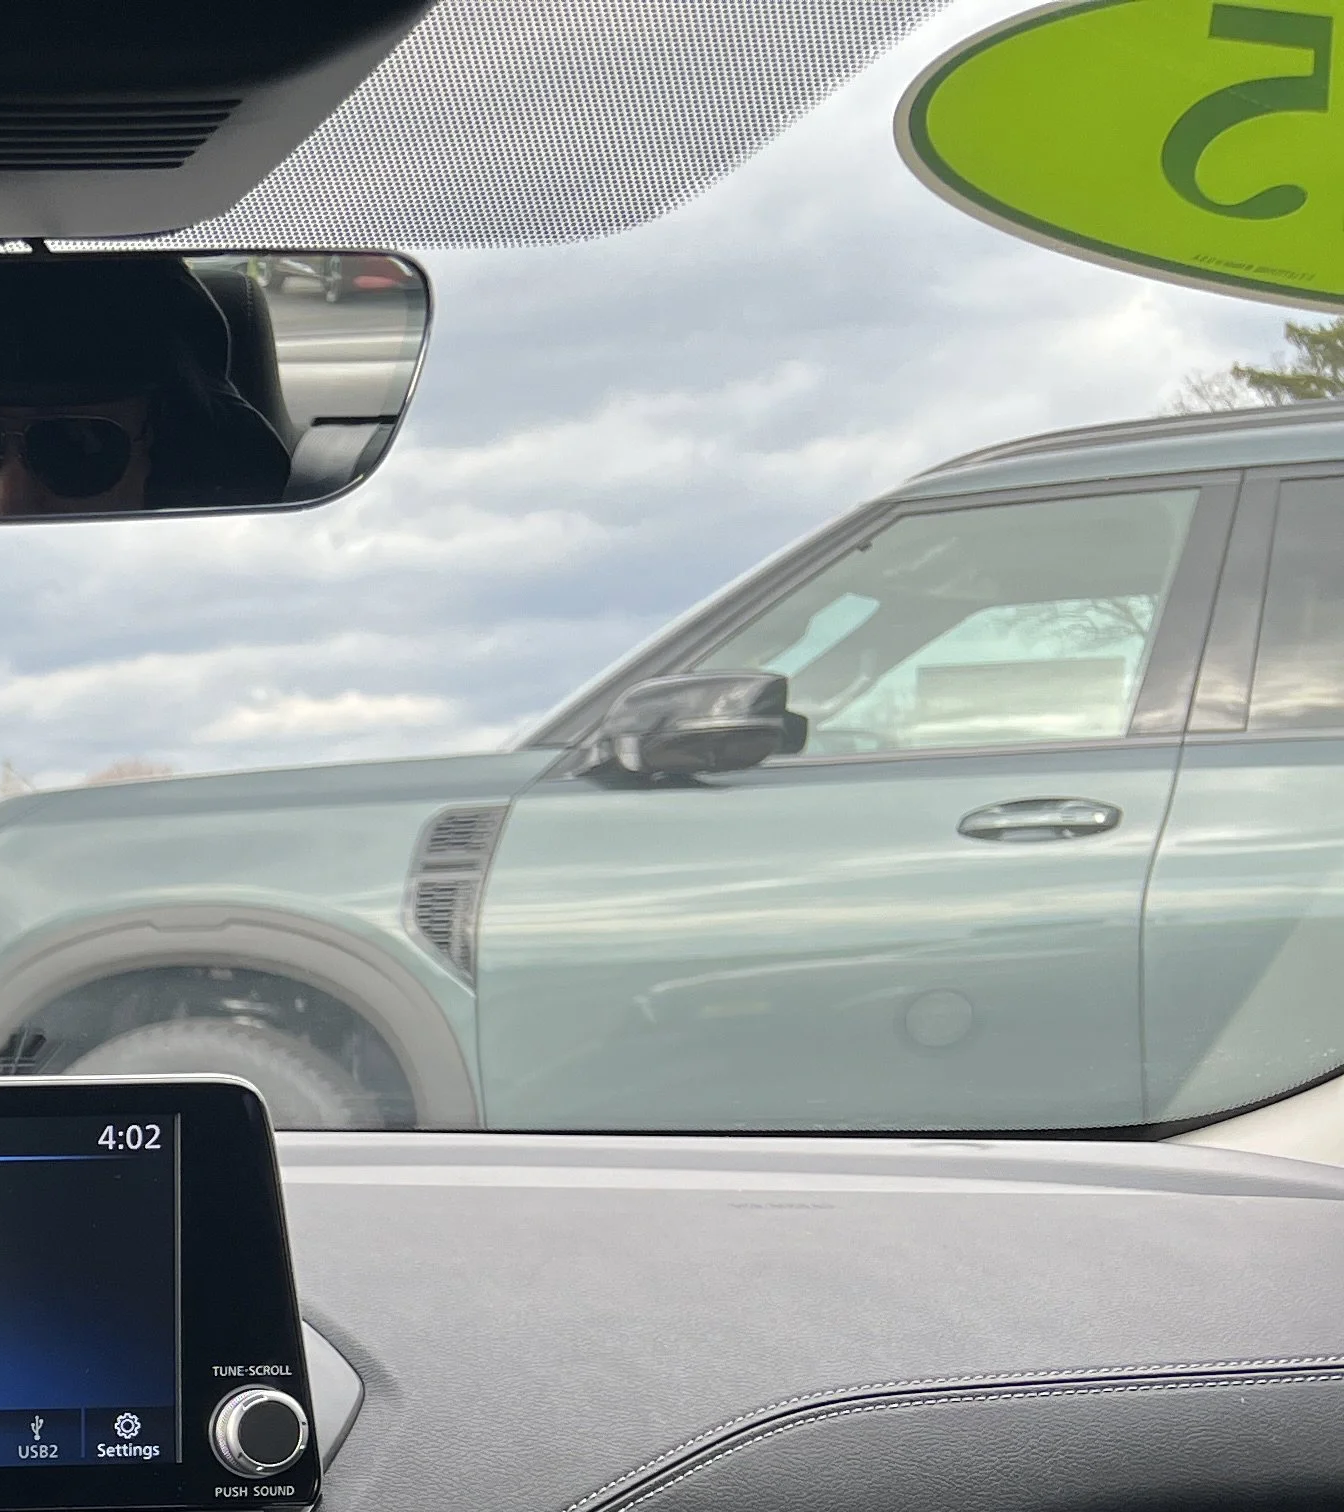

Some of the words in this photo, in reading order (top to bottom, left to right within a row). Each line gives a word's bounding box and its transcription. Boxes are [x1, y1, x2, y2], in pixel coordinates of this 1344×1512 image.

[97, 1124, 162, 1150] 4:02
[18, 1444, 59, 1460] USB2
[96, 1443, 160, 1460] Settings
[215, 1486, 248, 1498] PUSH
[253, 1485, 295, 1497] SOUND
